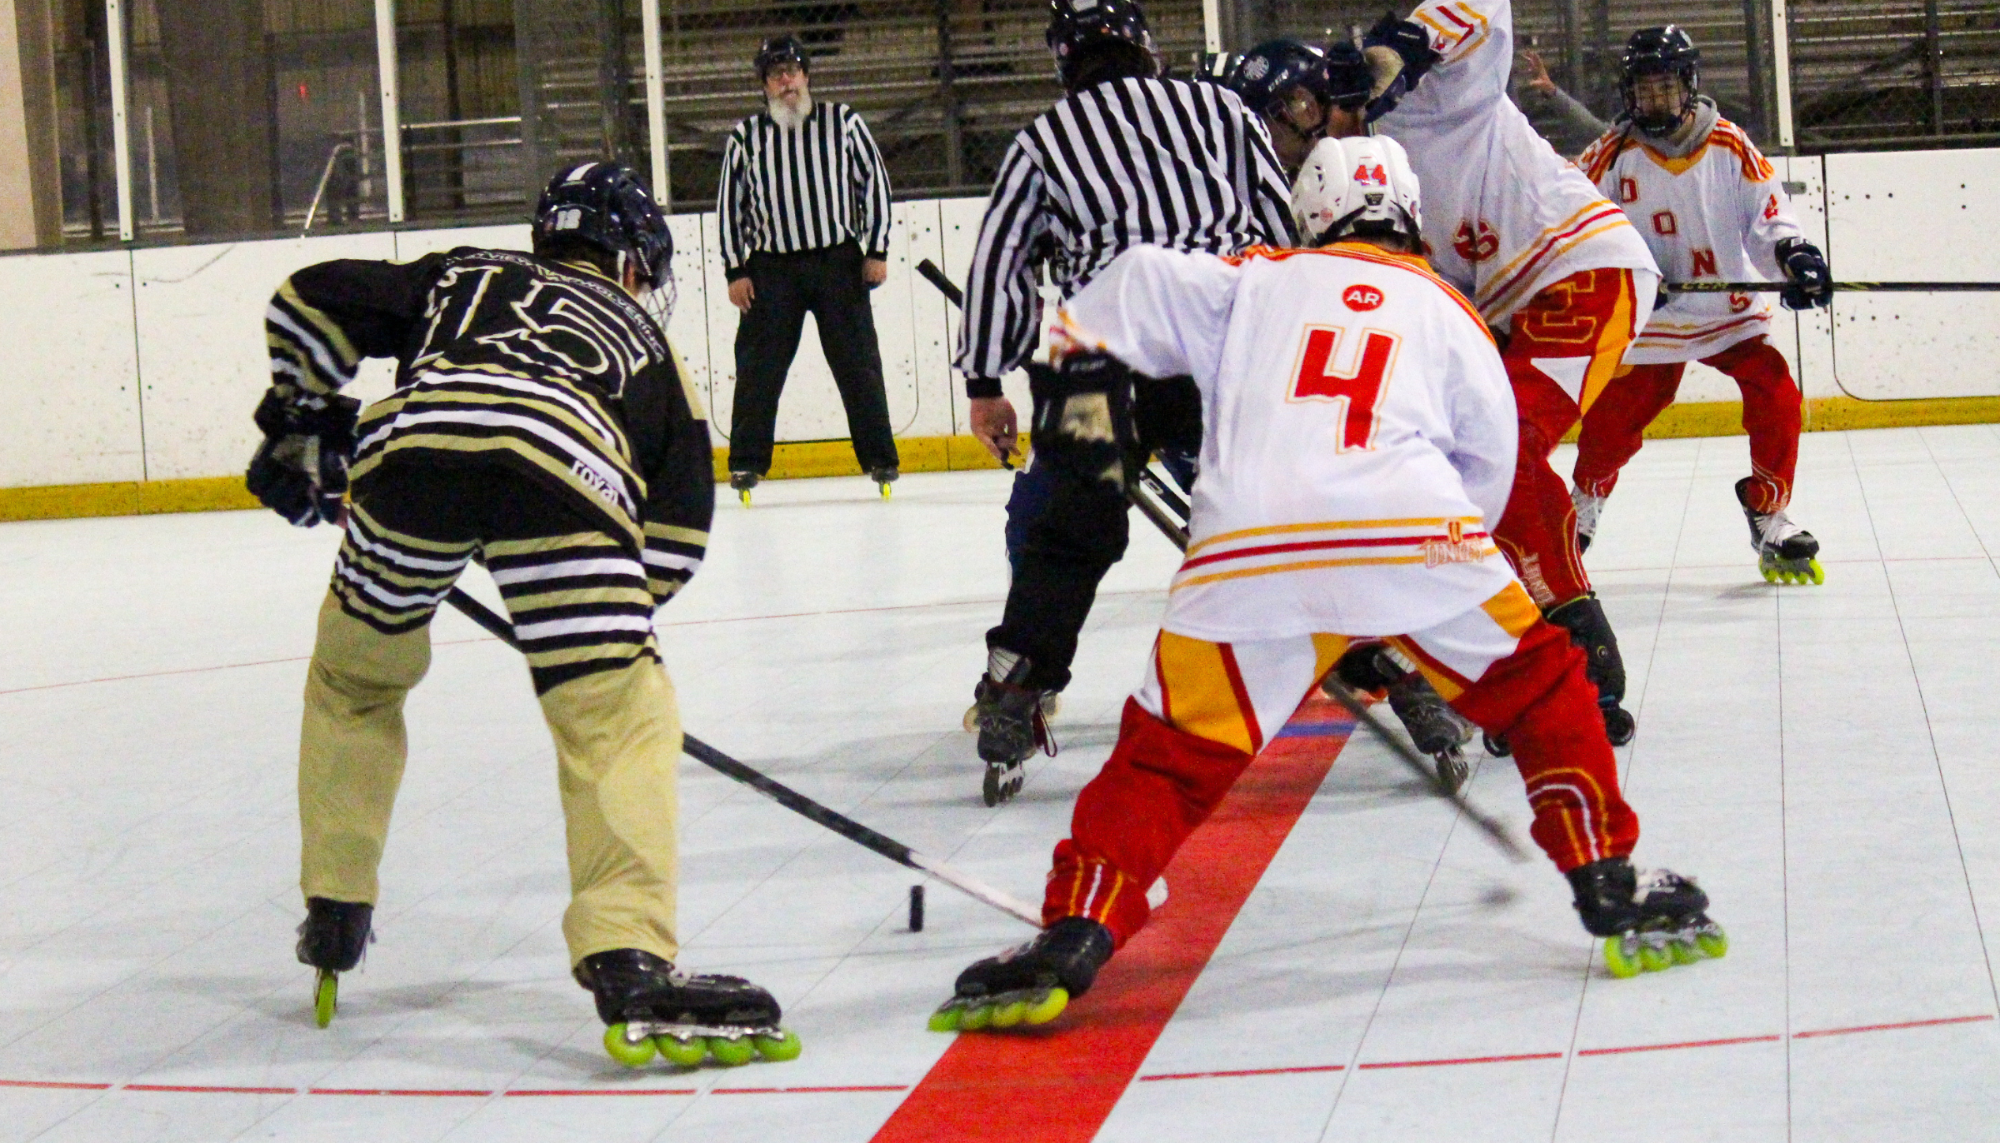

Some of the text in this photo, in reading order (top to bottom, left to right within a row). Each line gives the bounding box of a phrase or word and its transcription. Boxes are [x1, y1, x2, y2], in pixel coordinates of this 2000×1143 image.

[1353, 164, 1387, 186] 44
[410, 264, 649, 400] 15
[1346, 289, 1380, 306] AR
[1284, 322, 1403, 456] 4
